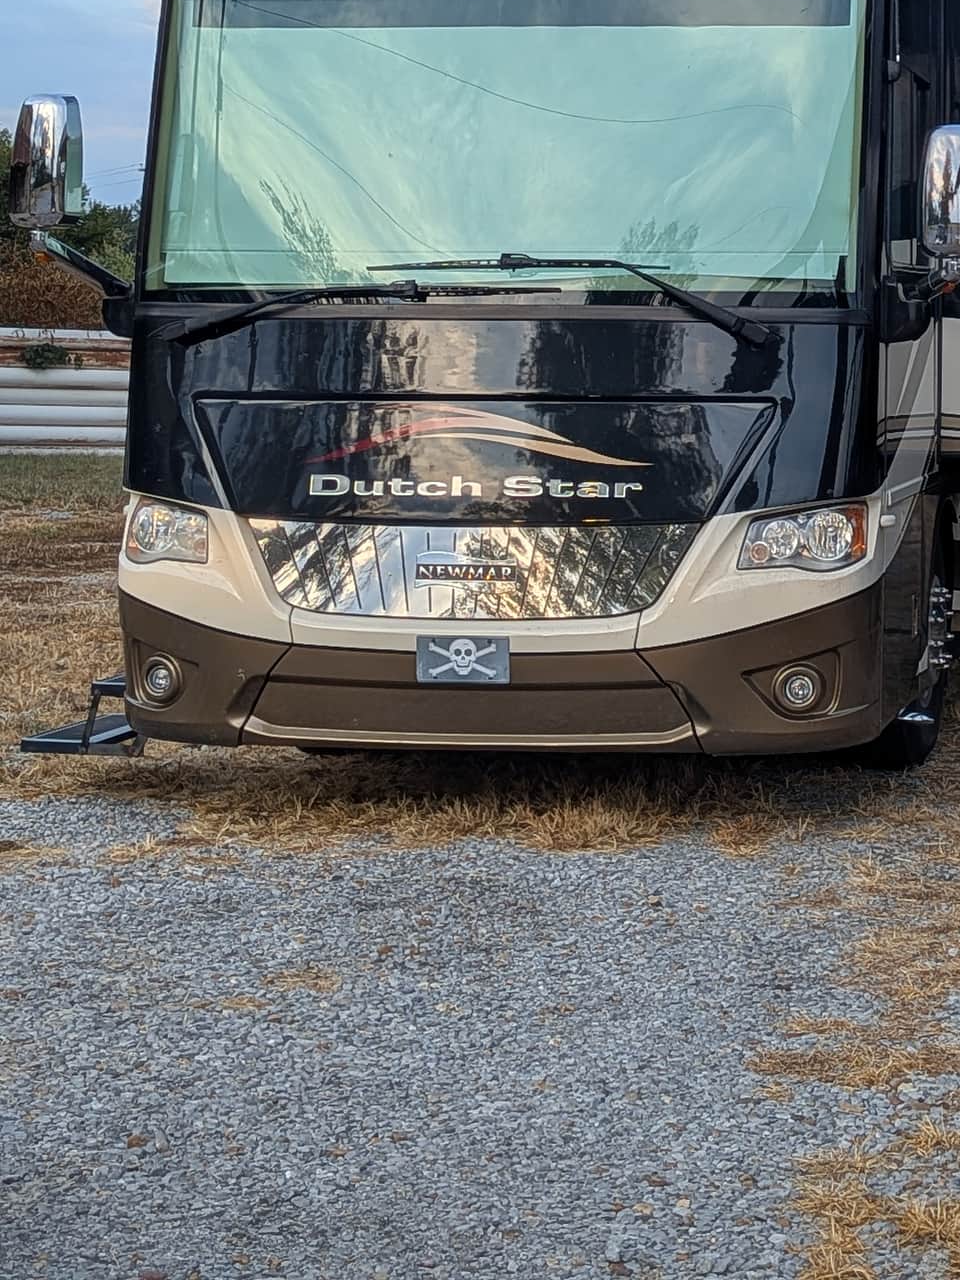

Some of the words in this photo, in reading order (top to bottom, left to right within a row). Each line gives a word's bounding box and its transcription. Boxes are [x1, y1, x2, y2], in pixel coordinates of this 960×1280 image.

[309, 474, 482, 497] Dutch
[503, 475, 643, 498] Star
[419, 565, 512, 580] NEWMAR
